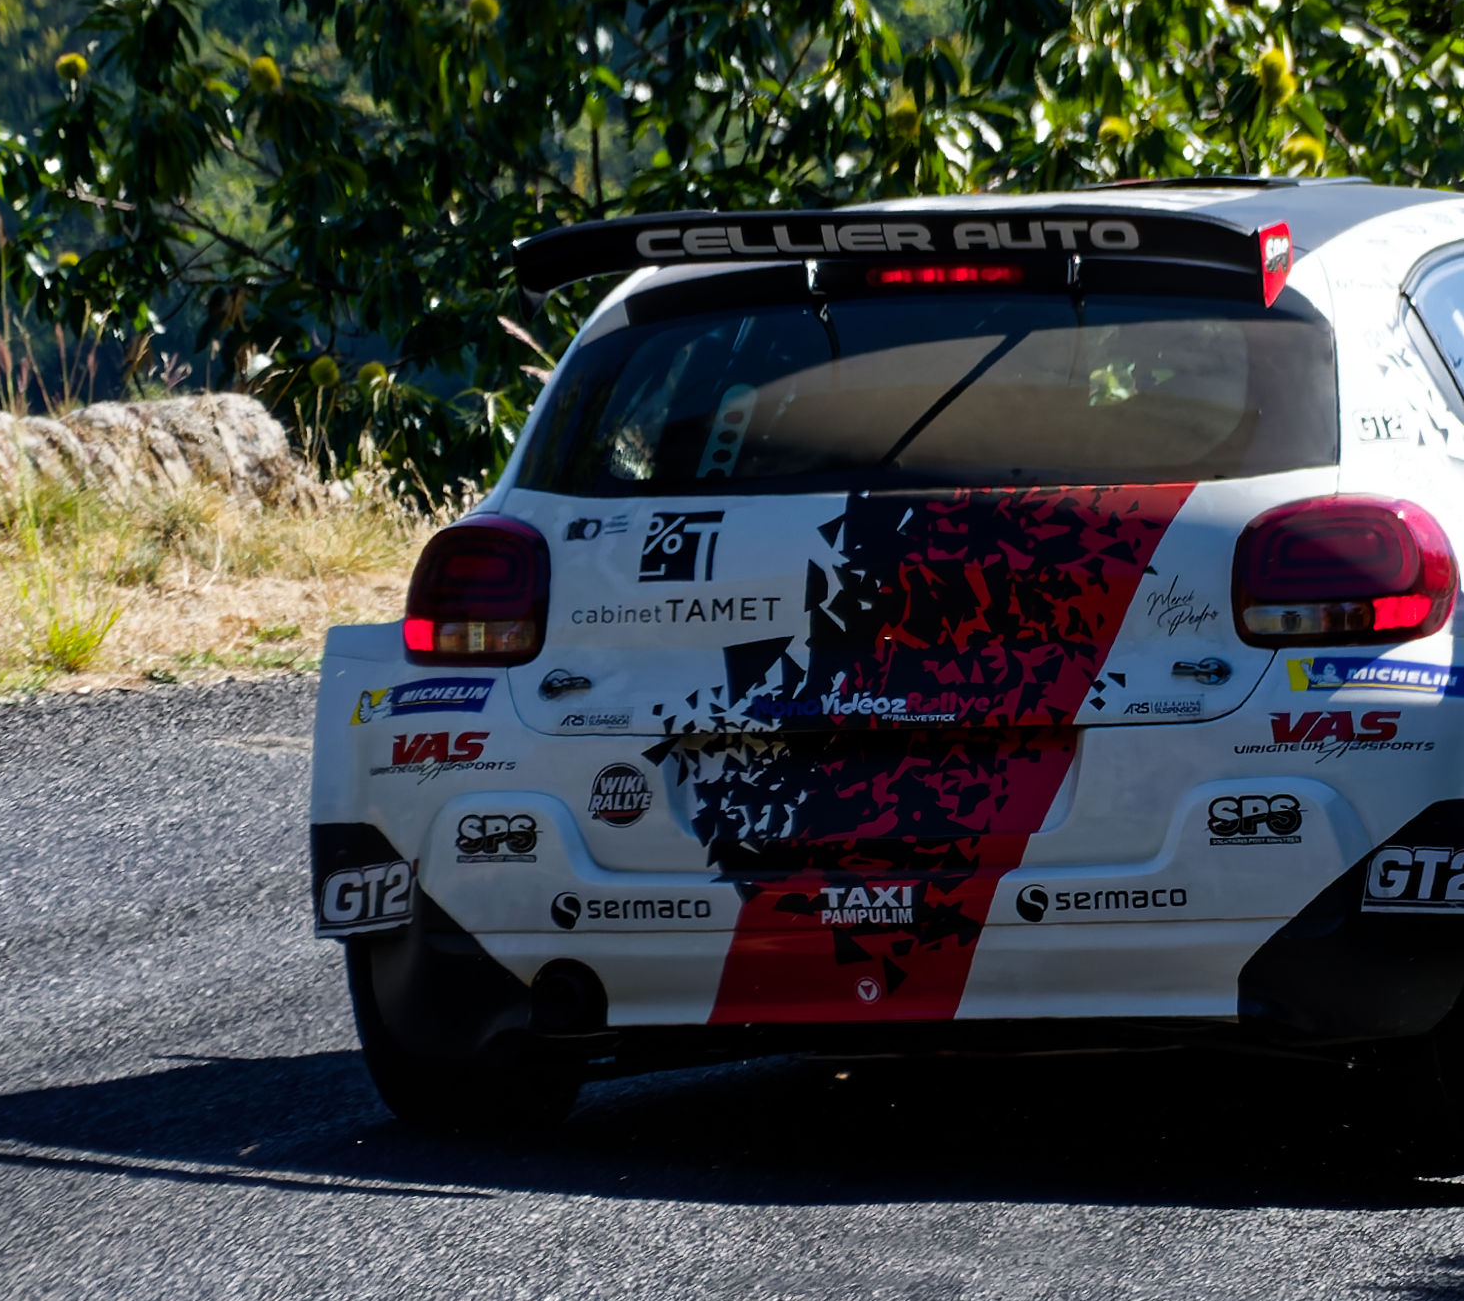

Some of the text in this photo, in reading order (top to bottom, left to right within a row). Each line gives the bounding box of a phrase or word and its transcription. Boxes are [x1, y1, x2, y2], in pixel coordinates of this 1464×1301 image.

[636, 220, 1140, 258] CELLIER AUTO
[1346, 667, 1458, 687] MICHELIN
[398, 685, 492, 702] MICHELIN
[1268, 710, 1402, 744] VAS
[391, 731, 491, 765] VAS
[599, 775, 645, 794] WIKI
[590, 792, 652, 812] RALLYE
[1207, 793, 1303, 837] SPS
[455, 813, 538, 855] SPS
[820, 886, 913, 908] TAXI
[1054, 888, 1189, 911] sermaco
[586, 899, 712, 919] sermaco
[821, 907, 914, 925] PAMPULIM
